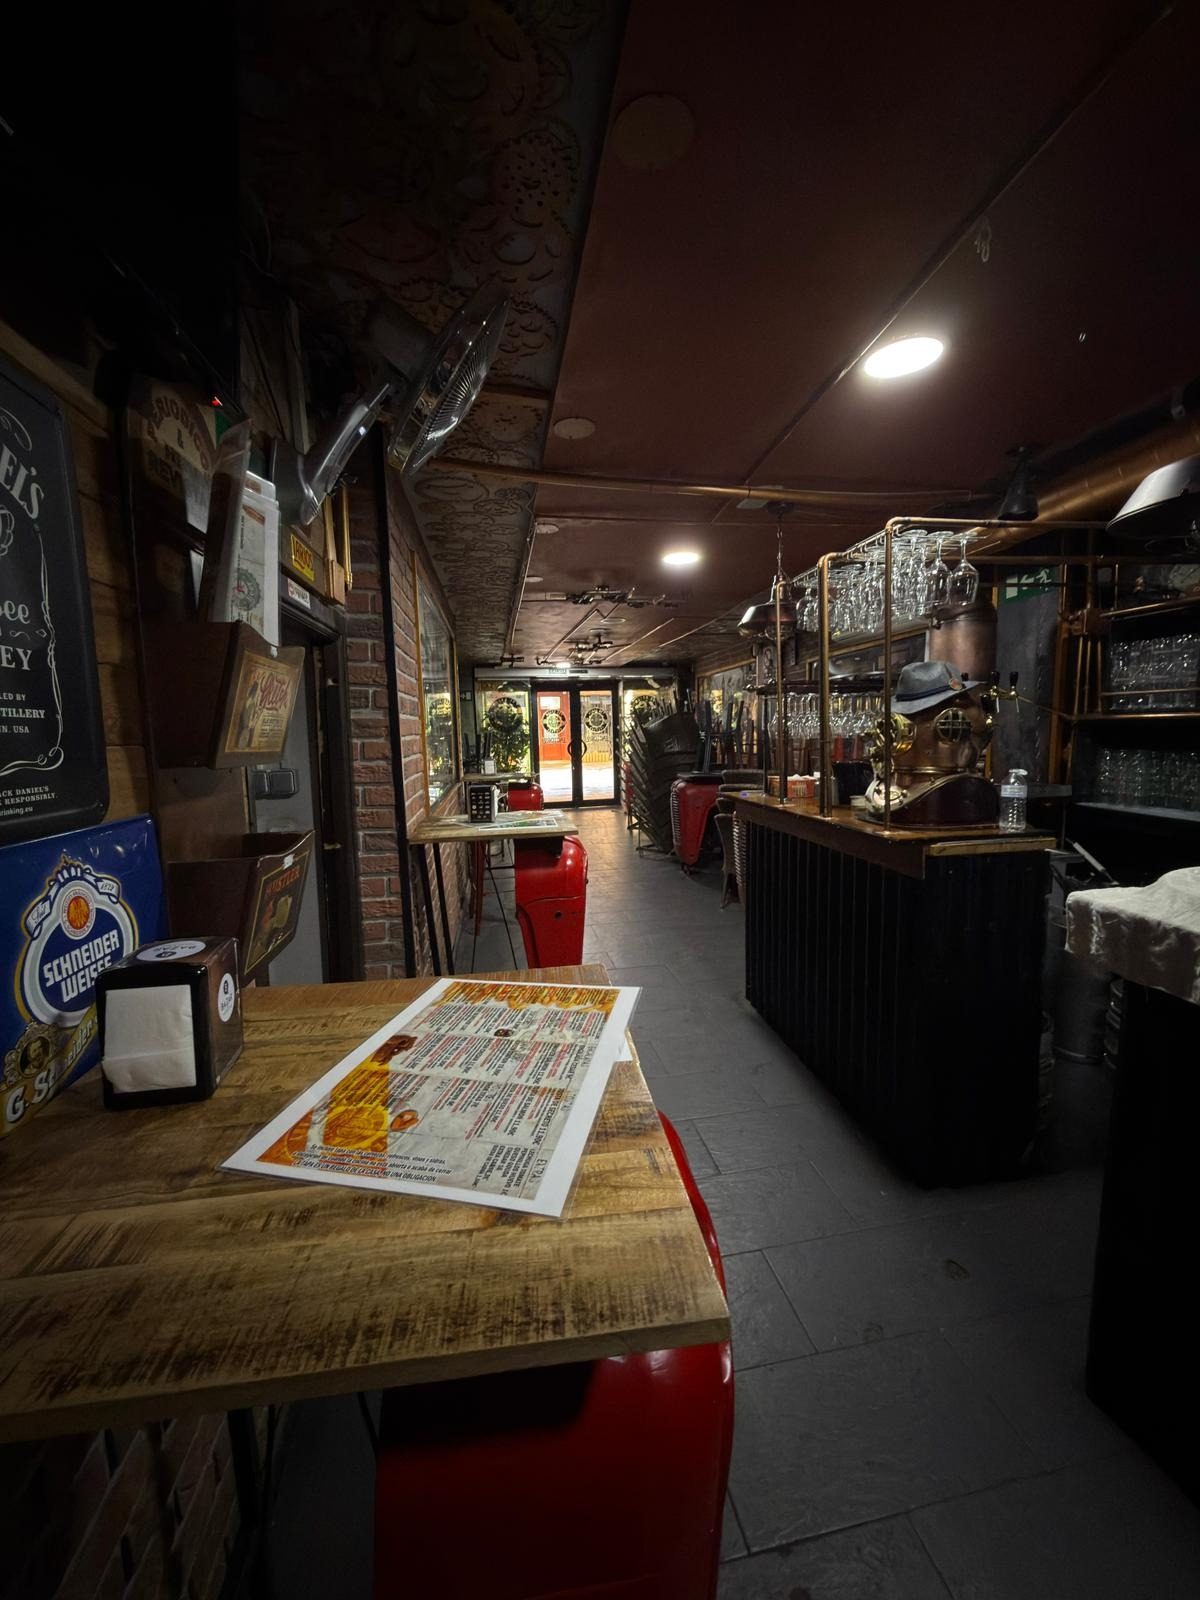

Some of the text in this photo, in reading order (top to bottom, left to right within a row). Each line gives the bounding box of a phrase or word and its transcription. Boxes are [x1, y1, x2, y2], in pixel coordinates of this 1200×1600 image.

[0, 600, 31, 624] ee
[16, 692, 26, 701] BY
[13, 725, 30, 734] USA
[42, 929, 120, 988] SCHNEIDER
